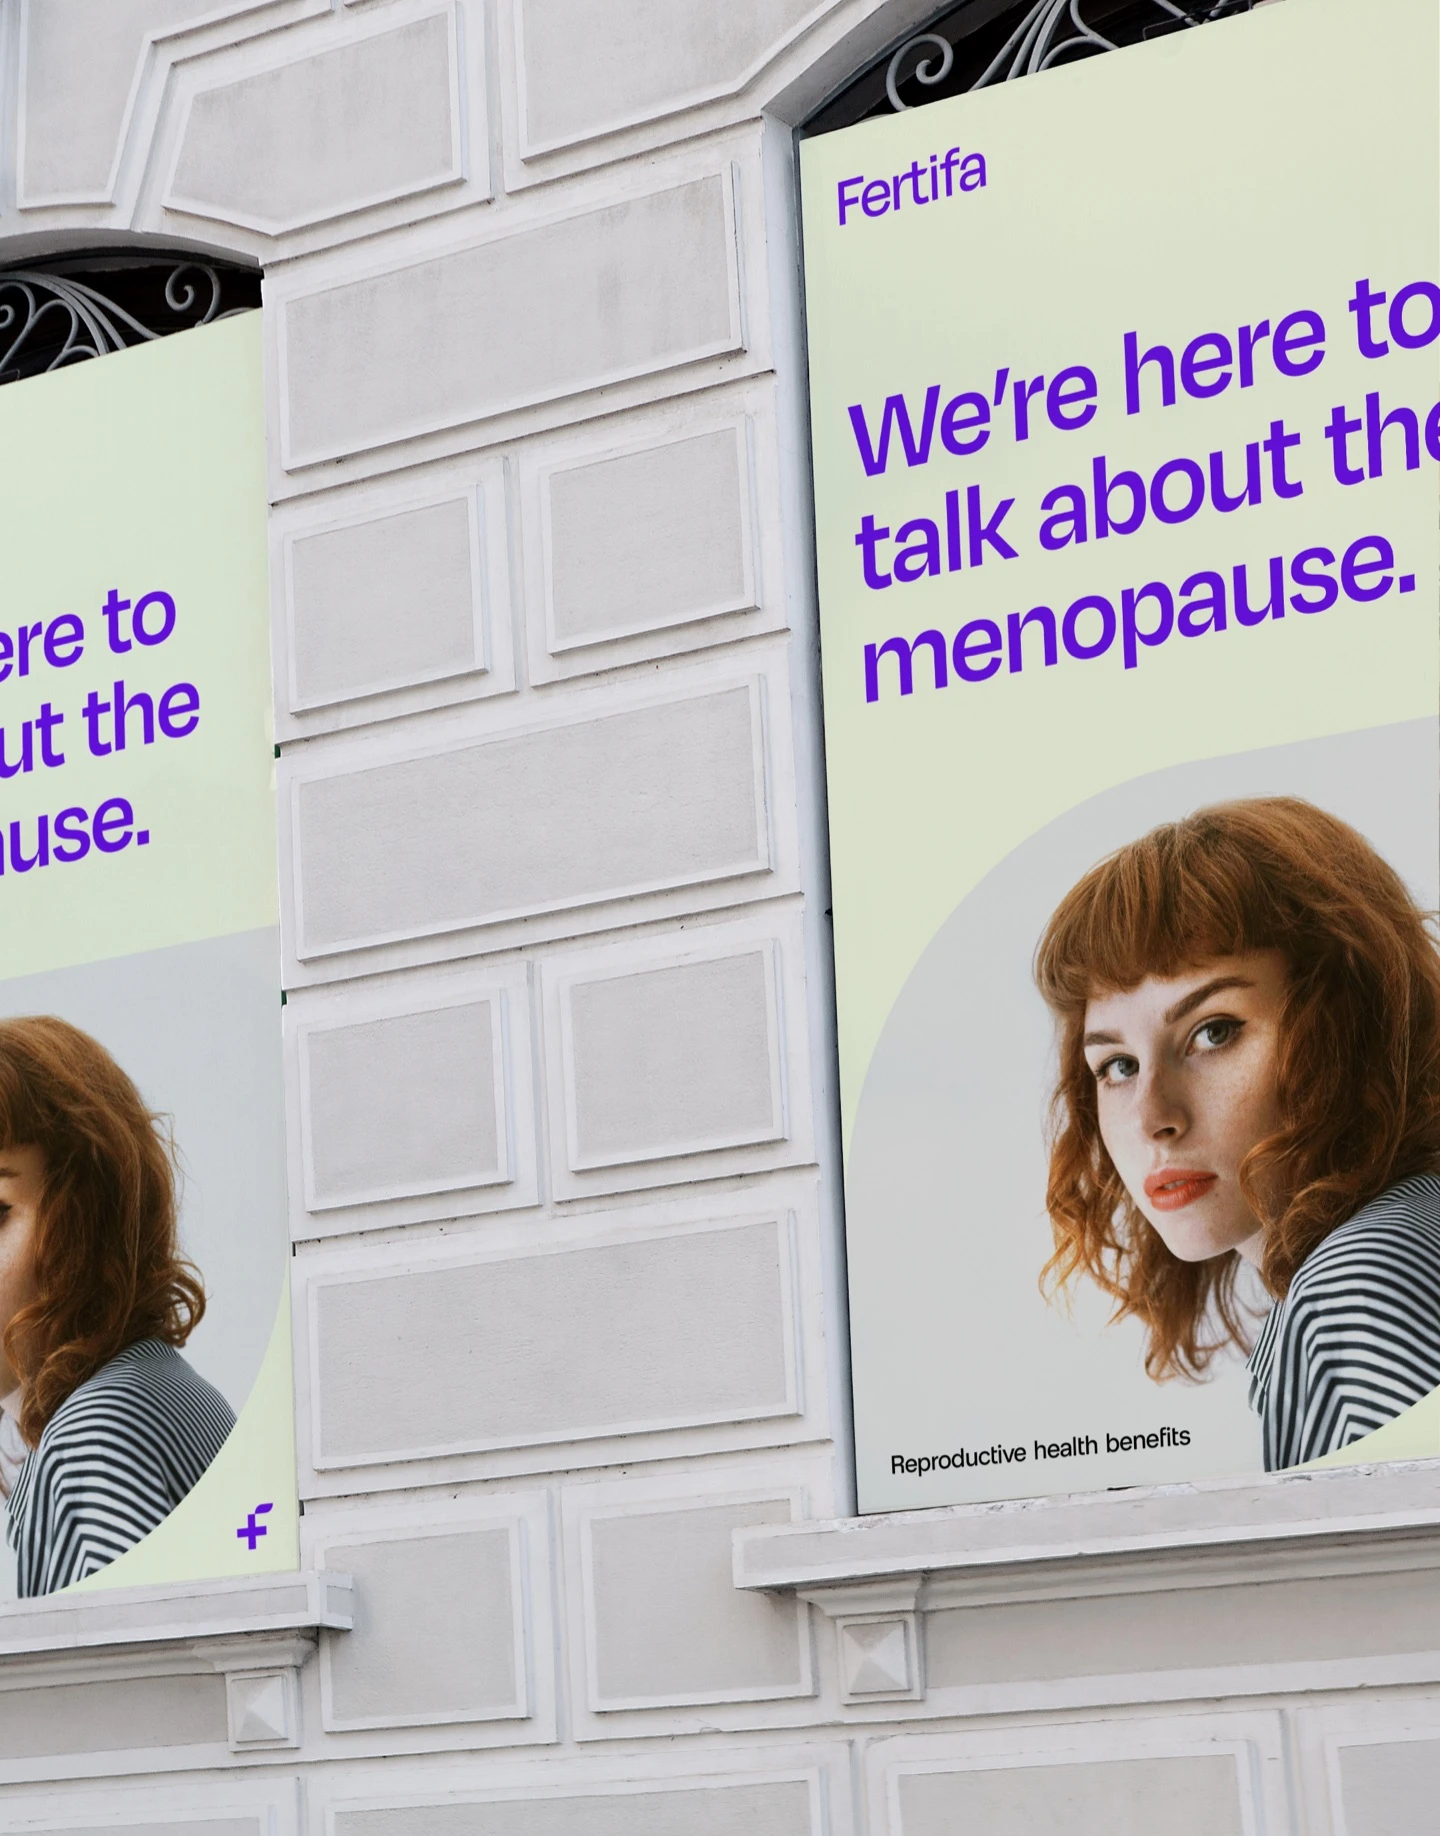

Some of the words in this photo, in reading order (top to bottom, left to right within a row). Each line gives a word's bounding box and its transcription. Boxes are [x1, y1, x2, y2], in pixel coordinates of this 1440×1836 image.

[837, 146, 987, 226] Fertifa
[847, 365, 1099, 477] We're
[1123, 309, 1327, 416] here
[1347, 278, 1440, 360] to
[854, 484, 1019, 591] talk
[1038, 419, 1304, 551] about
[101, 588, 177, 655] to
[863, 535, 1416, 704] menopause.
[81, 679, 201, 757] the
[891, 1443, 1027, 1478] Reproductive
[1034, 1435, 1098, 1461] health
[1106, 1426, 1191, 1453] benefits
